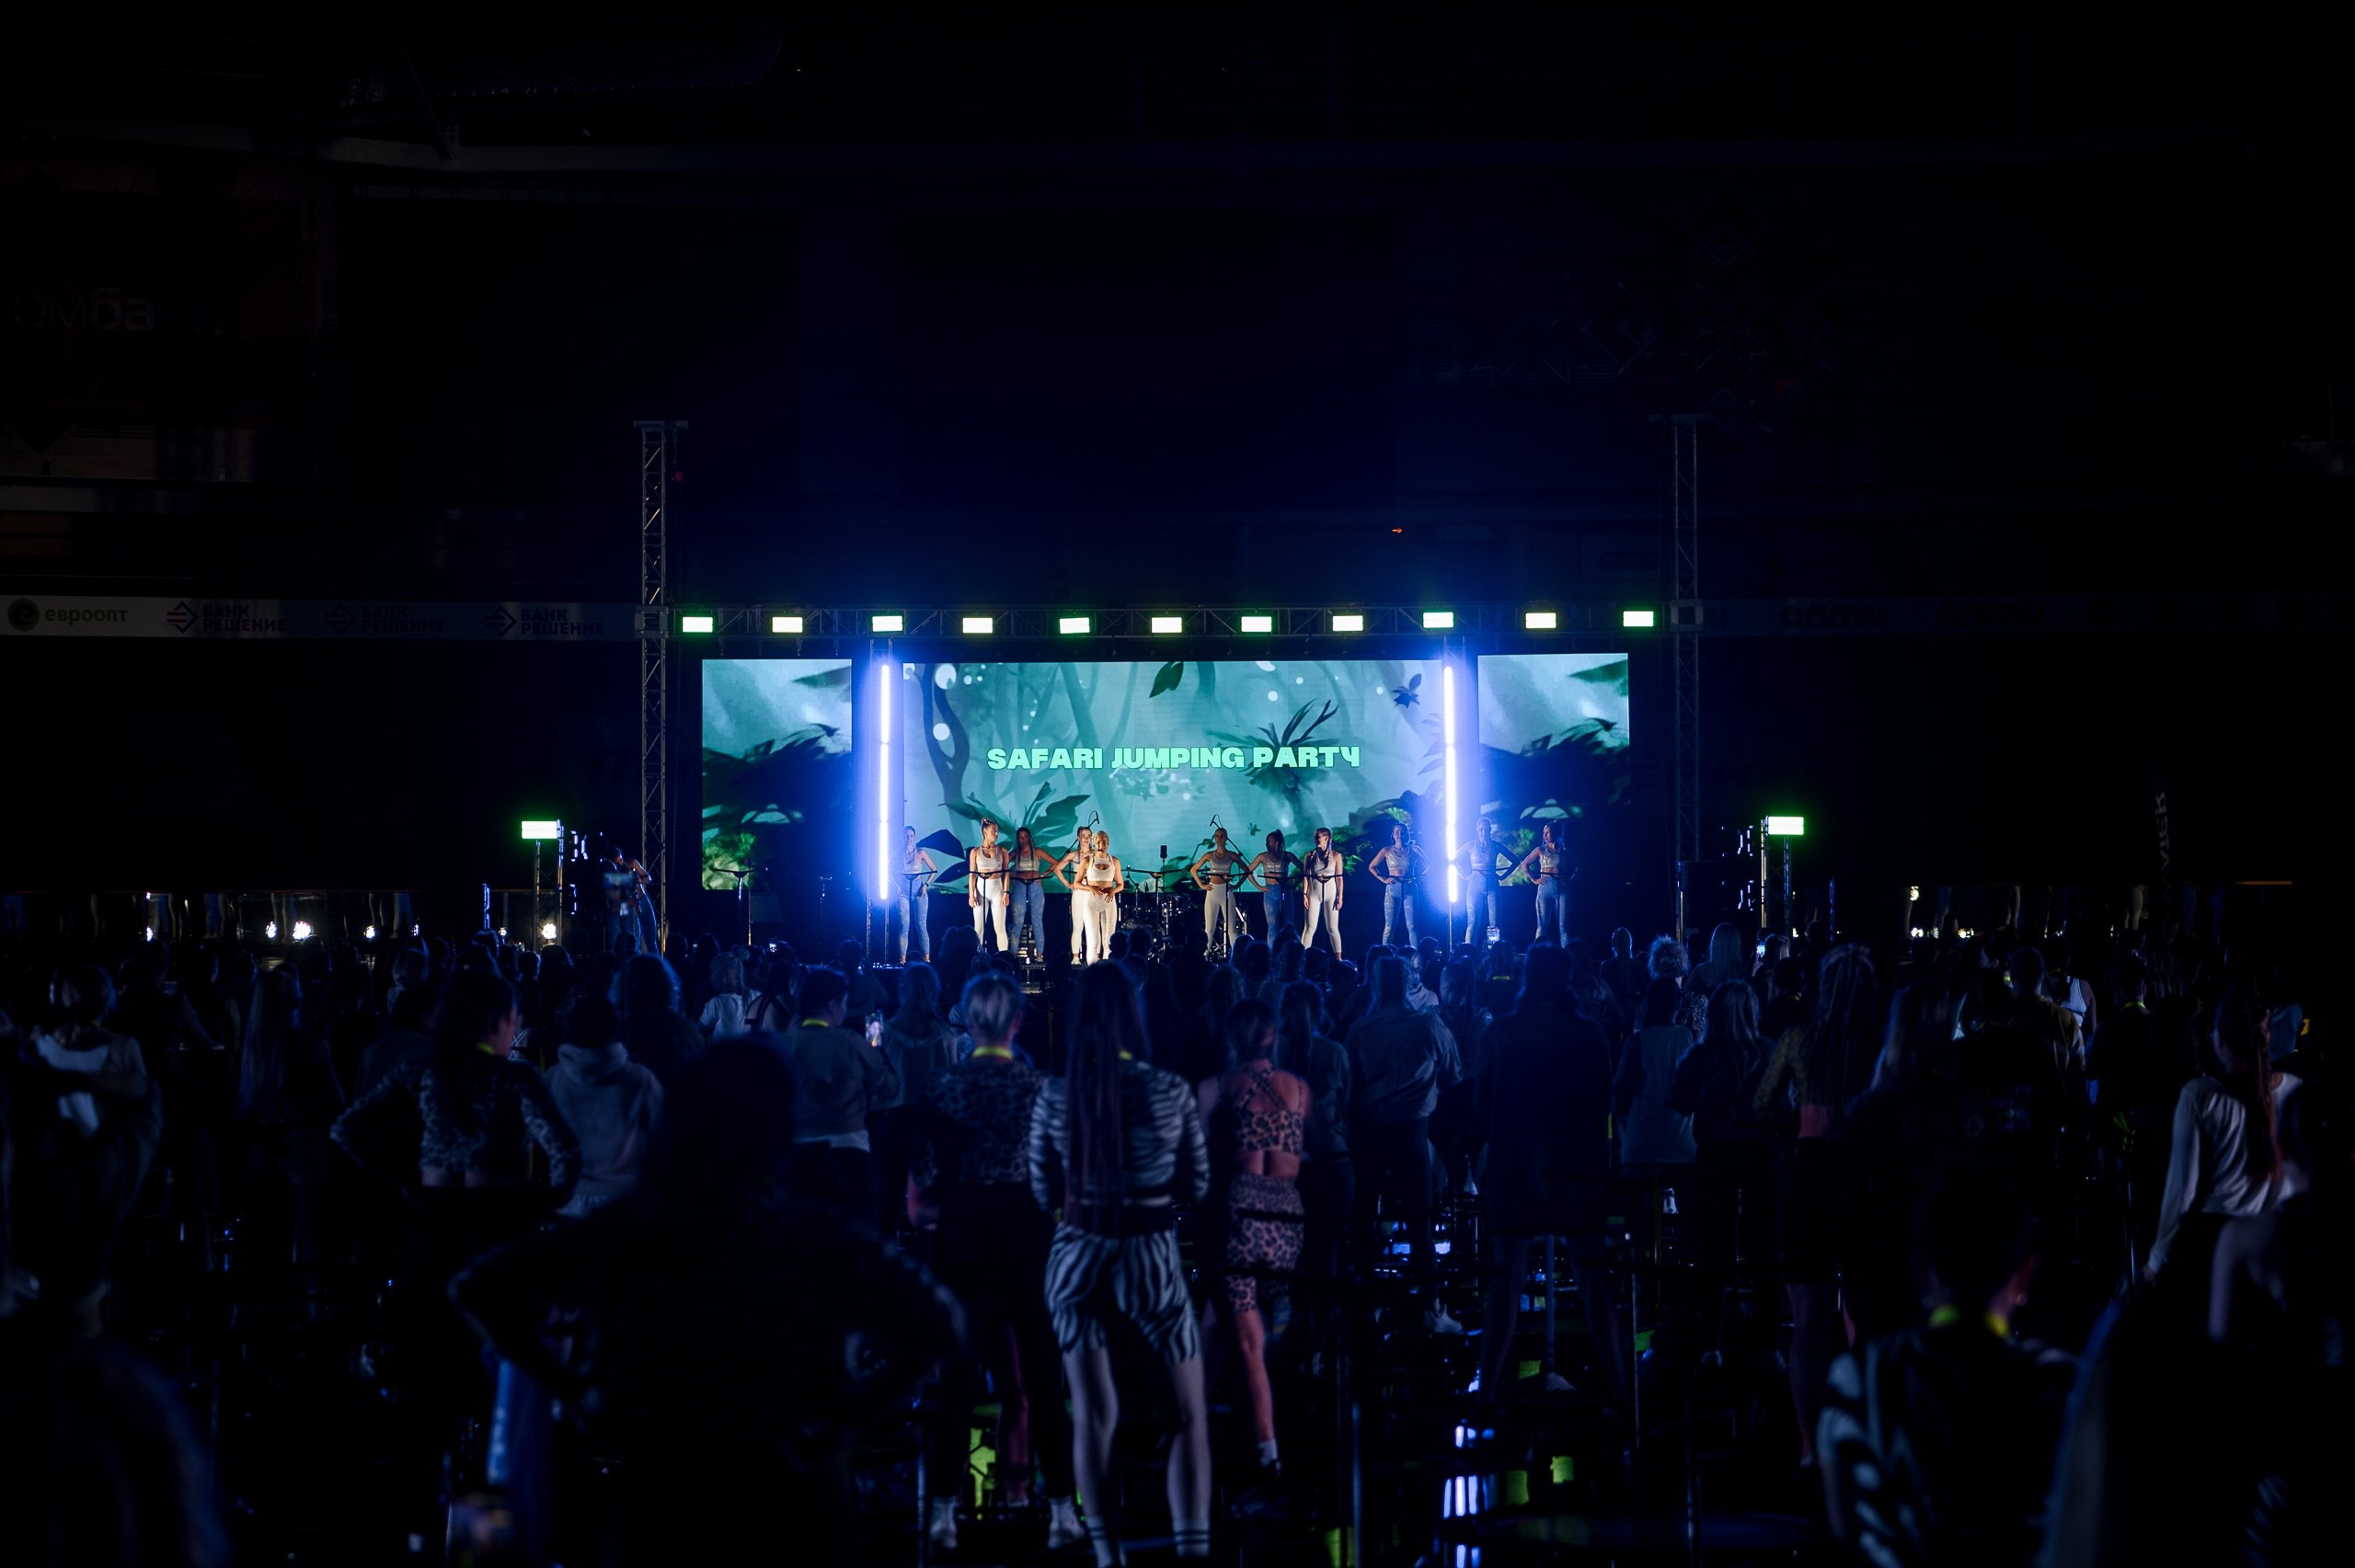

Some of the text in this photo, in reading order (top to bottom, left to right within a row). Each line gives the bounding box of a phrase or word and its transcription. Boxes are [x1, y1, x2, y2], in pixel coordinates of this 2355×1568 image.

[45, 608, 129, 625] евроопт
[202, 604, 250, 618] БАНК
[521, 608, 569, 622] БАНК
[202, 618, 287, 632] РЕШЕНИЕ
[521, 622, 604, 635] РЕШЕНИЕ
[987, 746, 1360, 769] SAFARI JUMPING PARTY
